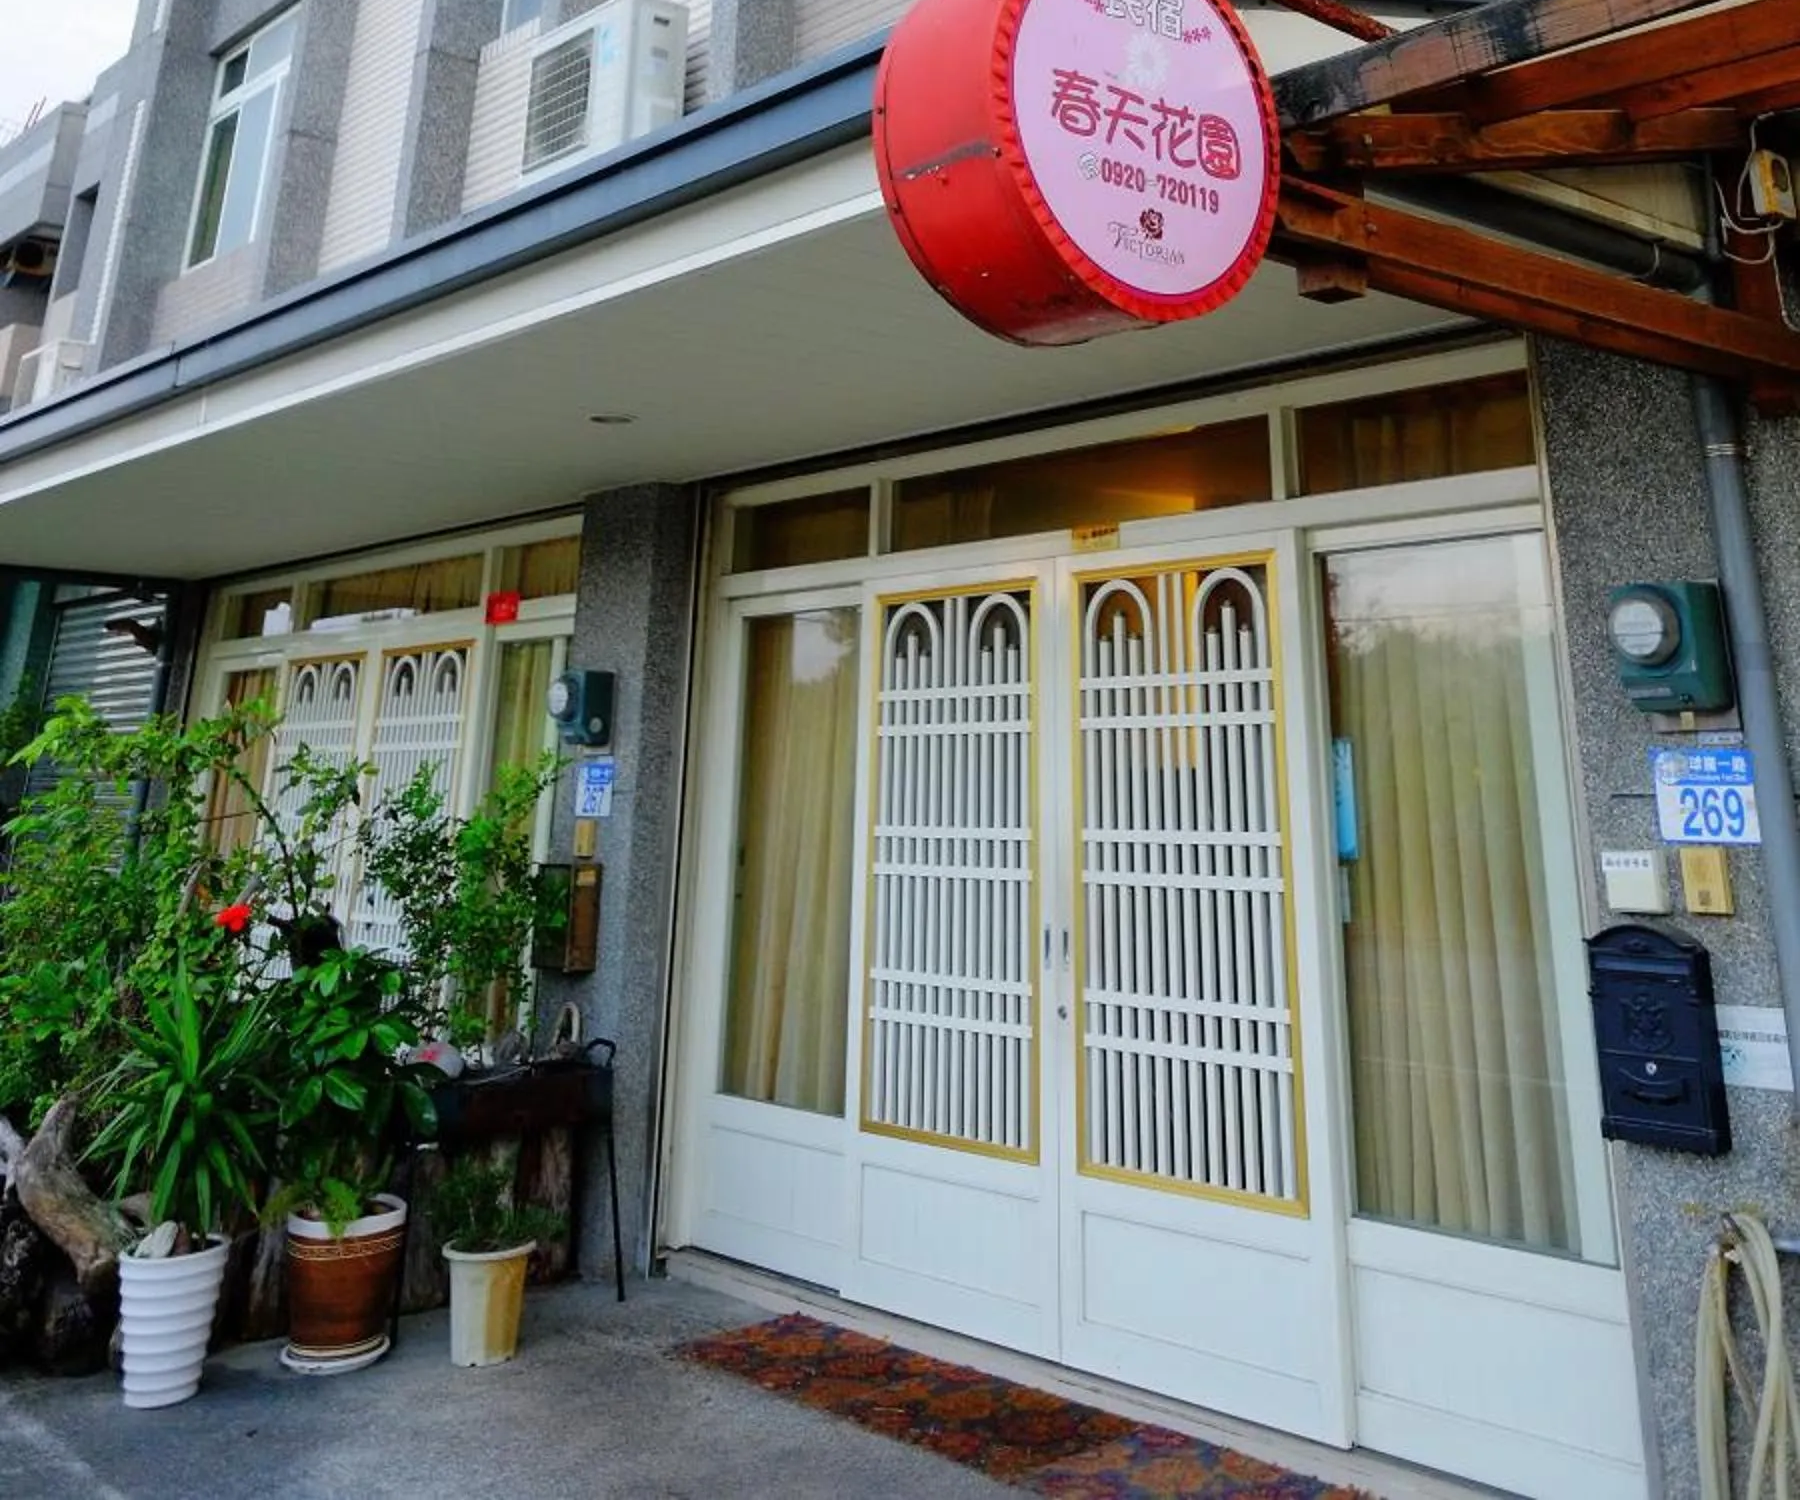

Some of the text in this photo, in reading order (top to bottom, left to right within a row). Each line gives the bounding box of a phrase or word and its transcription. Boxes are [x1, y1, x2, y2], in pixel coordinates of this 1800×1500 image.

[1051, 68, 1241, 180] 春天花園
[1100, 157, 1220, 214] 0920-720119
[1680, 787, 1746, 838] 269
